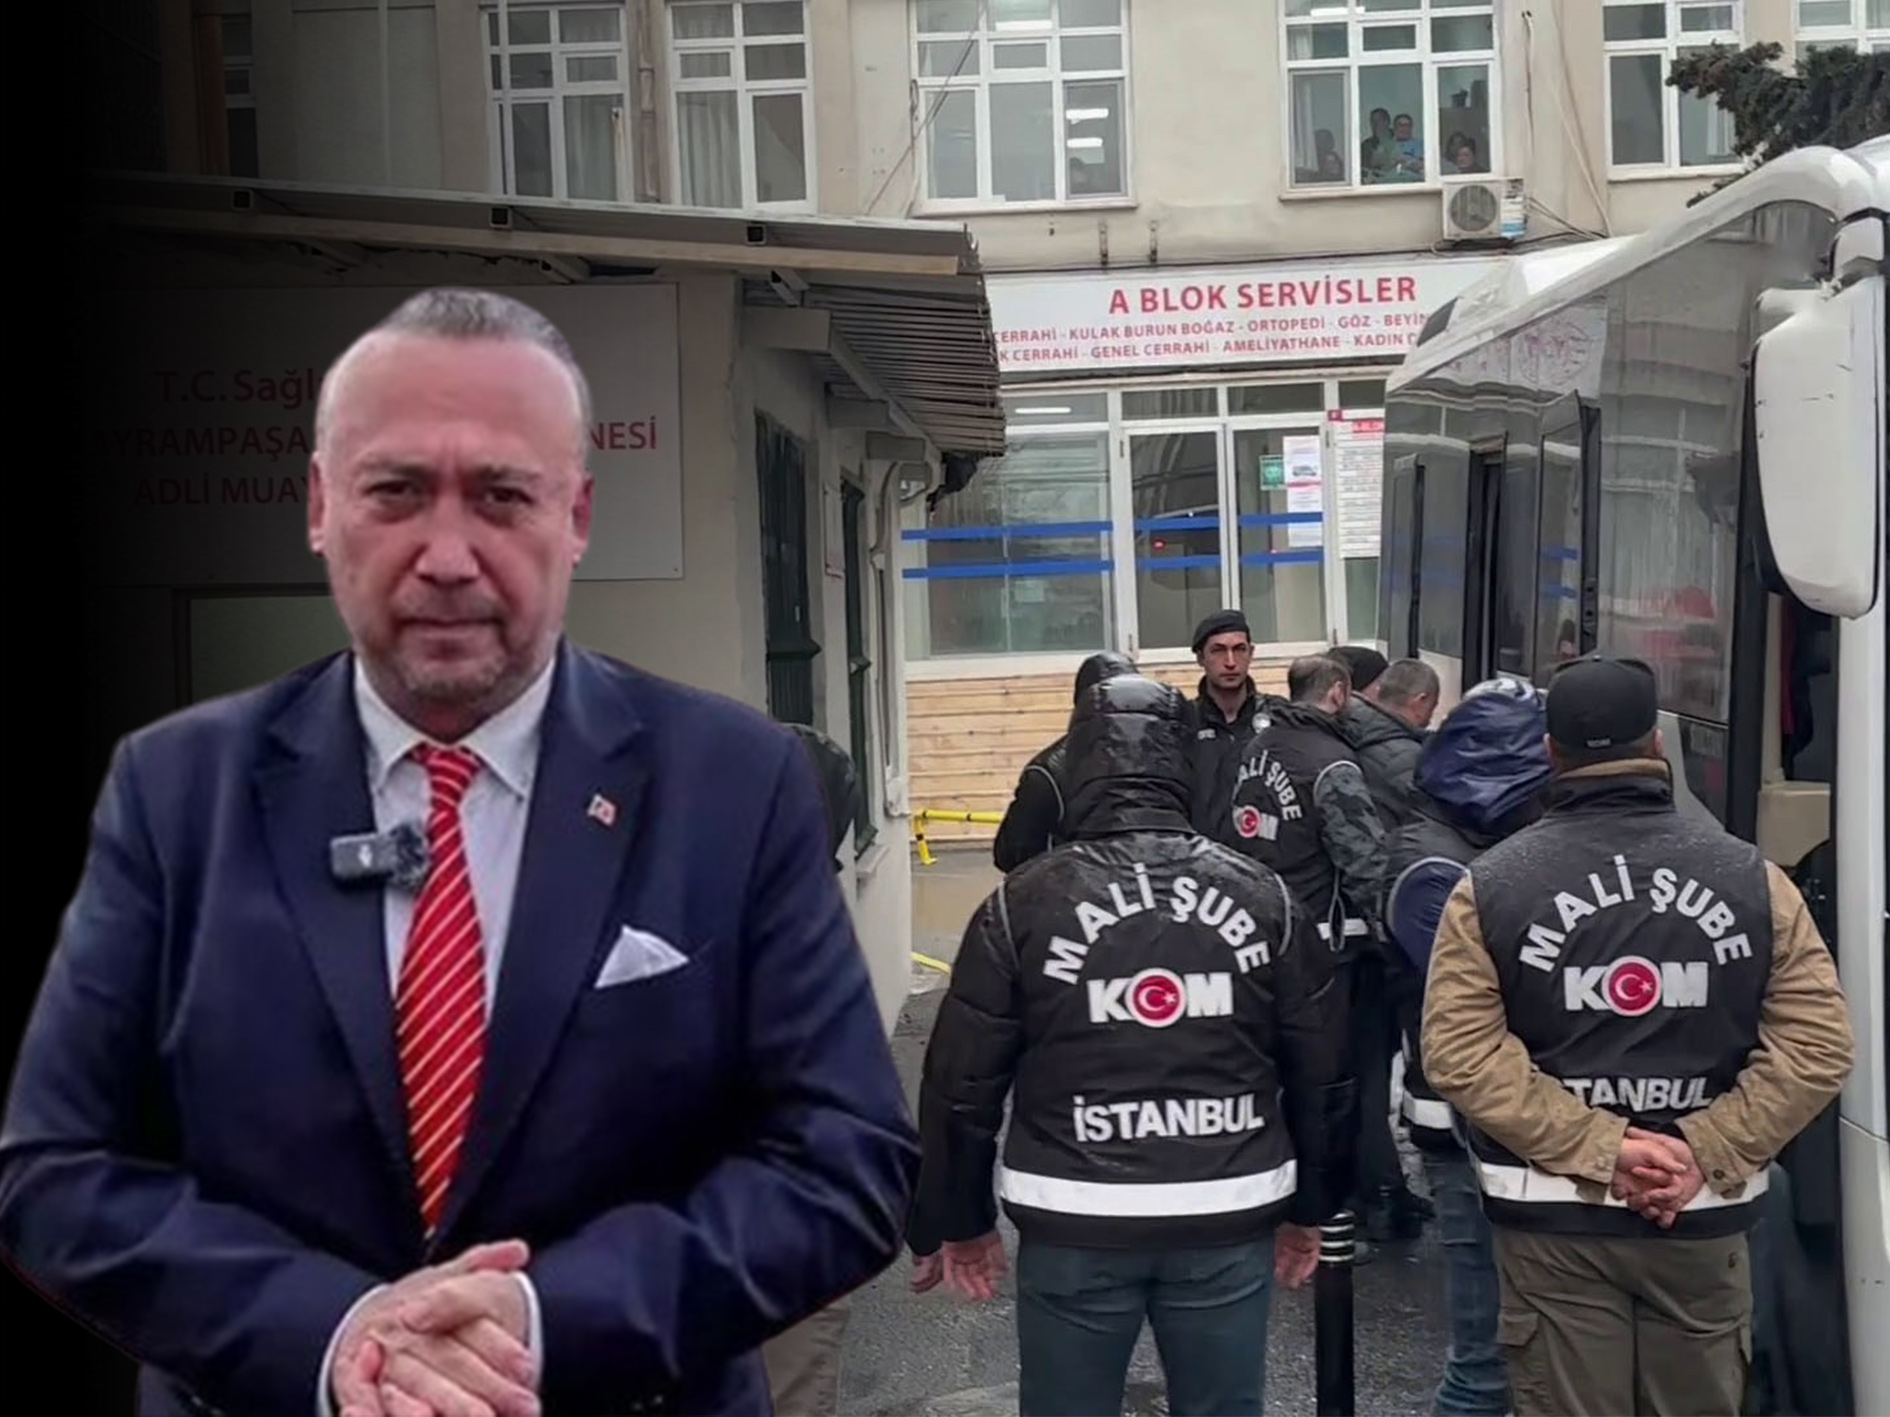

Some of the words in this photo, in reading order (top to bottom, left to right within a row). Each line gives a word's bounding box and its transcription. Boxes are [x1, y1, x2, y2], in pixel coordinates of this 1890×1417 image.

[1109, 289, 1129, 314] A
[1140, 285, 1227, 313] BLOK
[1237, 274, 1416, 309] SERVİSLER
[1069, 326, 1120, 341] KULAK
[1124, 323, 1177, 338] BURUN
[1181, 319, 1235, 336] BOĞAZ
[1247, 316, 1325, 333] ORTOPEDİ
[1338, 313, 1371, 329] GÖZ
[1013, 346, 1078, 361] CERRAHİ
[1091, 344, 1139, 358] GENEL
[1144, 341, 1209, 356] CERRAHİ
[1223, 335, 1340, 352] AMELİYATHANE
[1354, 333, 1403, 346] KADIN
[234, 368, 321, 410] Sağl
[590, 415, 656, 450] NESİ
[134, 473, 209, 505] ADLİ
[222, 476, 307, 504] MUA
[1043, 862, 1156, 985] MALİ
[1169, 876, 1271, 974] ŞUBE
[1519, 854, 1635, 973] MALİ
[1649, 868, 1753, 965] ŞUBE
[1562, 1077, 1713, 1112] TANBUL
[1072, 1094, 1265, 1142] İSTANBUL
